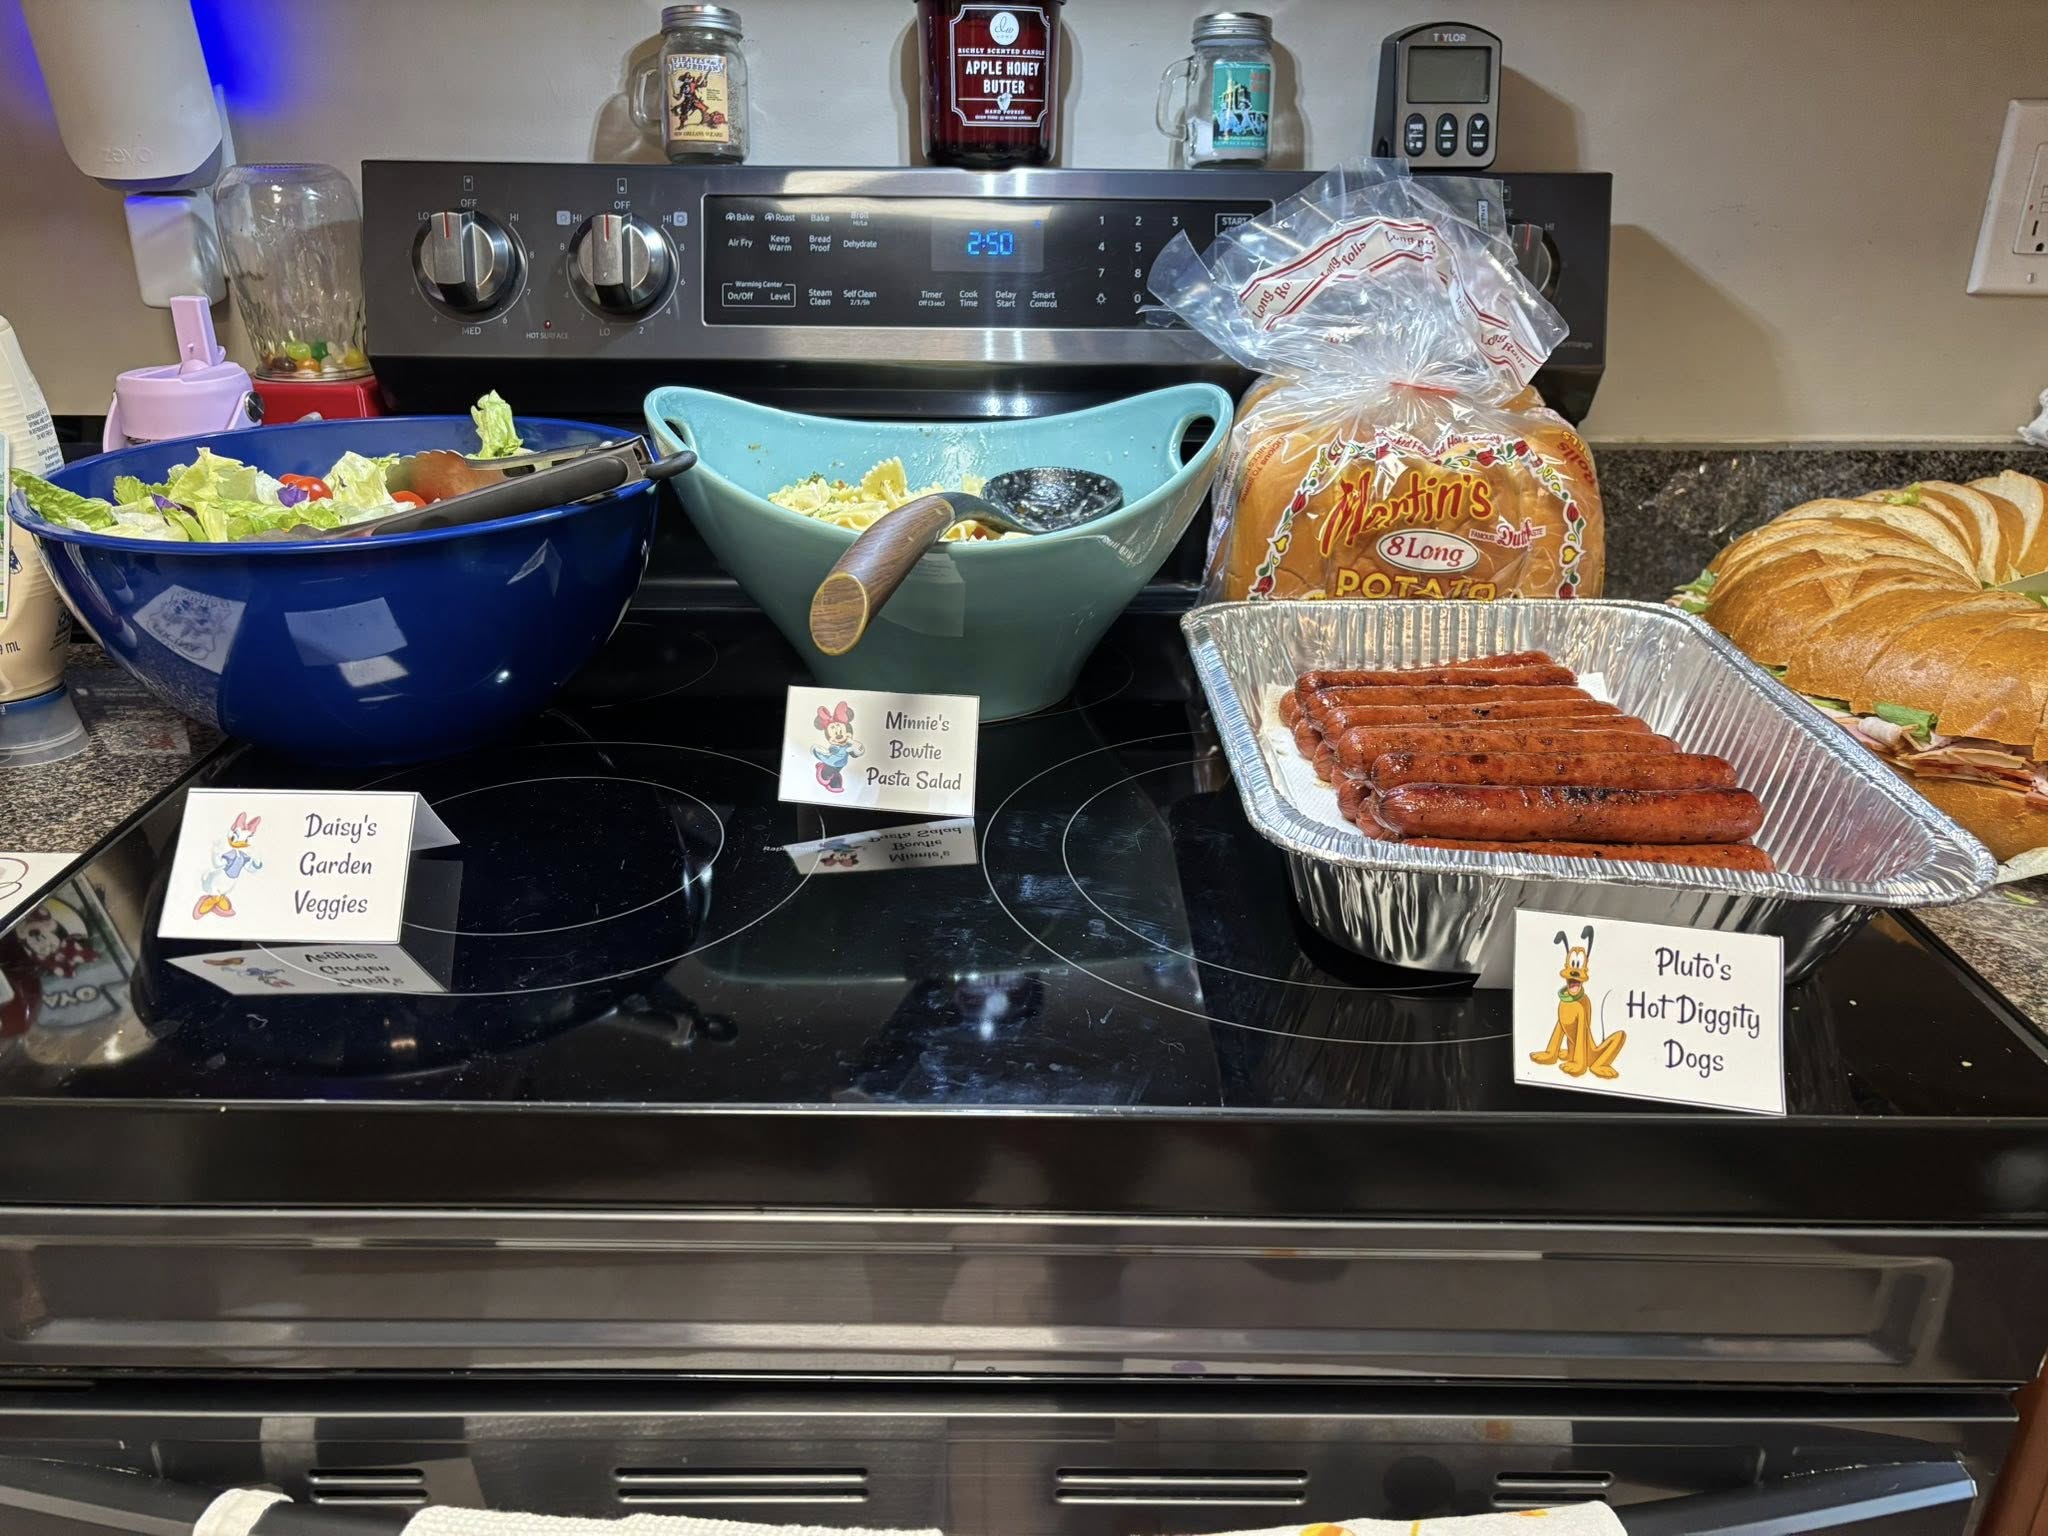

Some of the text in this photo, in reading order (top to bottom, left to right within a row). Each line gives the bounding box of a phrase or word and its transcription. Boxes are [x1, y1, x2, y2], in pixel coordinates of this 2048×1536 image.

[965, 60, 1040, 77] APPLE HONEY
[983, 79, 1026, 94] BUTTER
[460, 198, 478, 208] OFF
[613, 200, 631, 210] OFF
[417, 211, 430, 221] LO
[509, 212, 520, 222] HI
[572, 213, 583, 223] HI
[662, 214, 672, 223] HI
[736, 213, 755, 222] Bake
[775, 213, 796, 222] Roast
[810, 213, 830, 223] Bake
[1135, 216, 1142, 226] 2
[1171, 216, 1179, 227] 3
[1544, 222, 1555, 231] HI
[728, 238, 753, 249] Air Fry
[770, 235, 791, 245] Keep
[809, 235, 832, 244] Bread
[967, 231, 1014, 256] 2:50
[679, 242, 686, 252] 8
[768, 244, 792, 252] Warm
[809, 244, 831, 252] Proof
[843, 240, 878, 250] Dehydrate
[1098, 242, 1142, 252] 4 5
[529, 251, 536, 260] 8
[1098, 268, 1142, 278] 7 8
[680, 277, 687, 287] 6
[735, 281, 762, 289] Warming
[526, 288, 532, 297] 7
[727, 292, 754, 301] On/Off
[770, 292, 791, 301] Level
[808, 289, 833, 297] Steam
[843, 290, 877, 299] Self Clean
[921, 290, 942, 299] Timer
[959, 290, 978, 299] Cook
[995, 291, 1017, 300] Delay
[1032, 291, 1056, 300] Smart
[809, 298, 831, 306] Clean
[960, 299, 979, 308] Time
[996, 299, 1016, 308] Start
[1030, 300, 1058, 308] Control
[1134, 294, 1142, 304] 0
[1252, 289, 1275, 320] Long
[665, 306, 672, 316] 4
[461, 326, 482, 336] MED
[526, 331, 540, 340] HOT
[599, 328, 611, 337] LO
[638, 326, 645, 335] 2
[1321, 470, 1493, 556] Martin's
[1386, 535, 1465, 568] 8 Long
[1335, 568, 1497, 600] POTATO
[885, 710, 950, 732] Minnie's
[889, 739, 943, 760] Bowtie
[866, 766, 962, 790] Pasta Salad
[303, 812, 378, 844] Daisy's
[299, 850, 373, 877] Garden
[294, 889, 369, 920] Veggies
[1654, 946, 1733, 982] Pluto's
[1626, 989, 1761, 1040] Hot Diggity
[1663, 1038, 1725, 1079] Dogs
